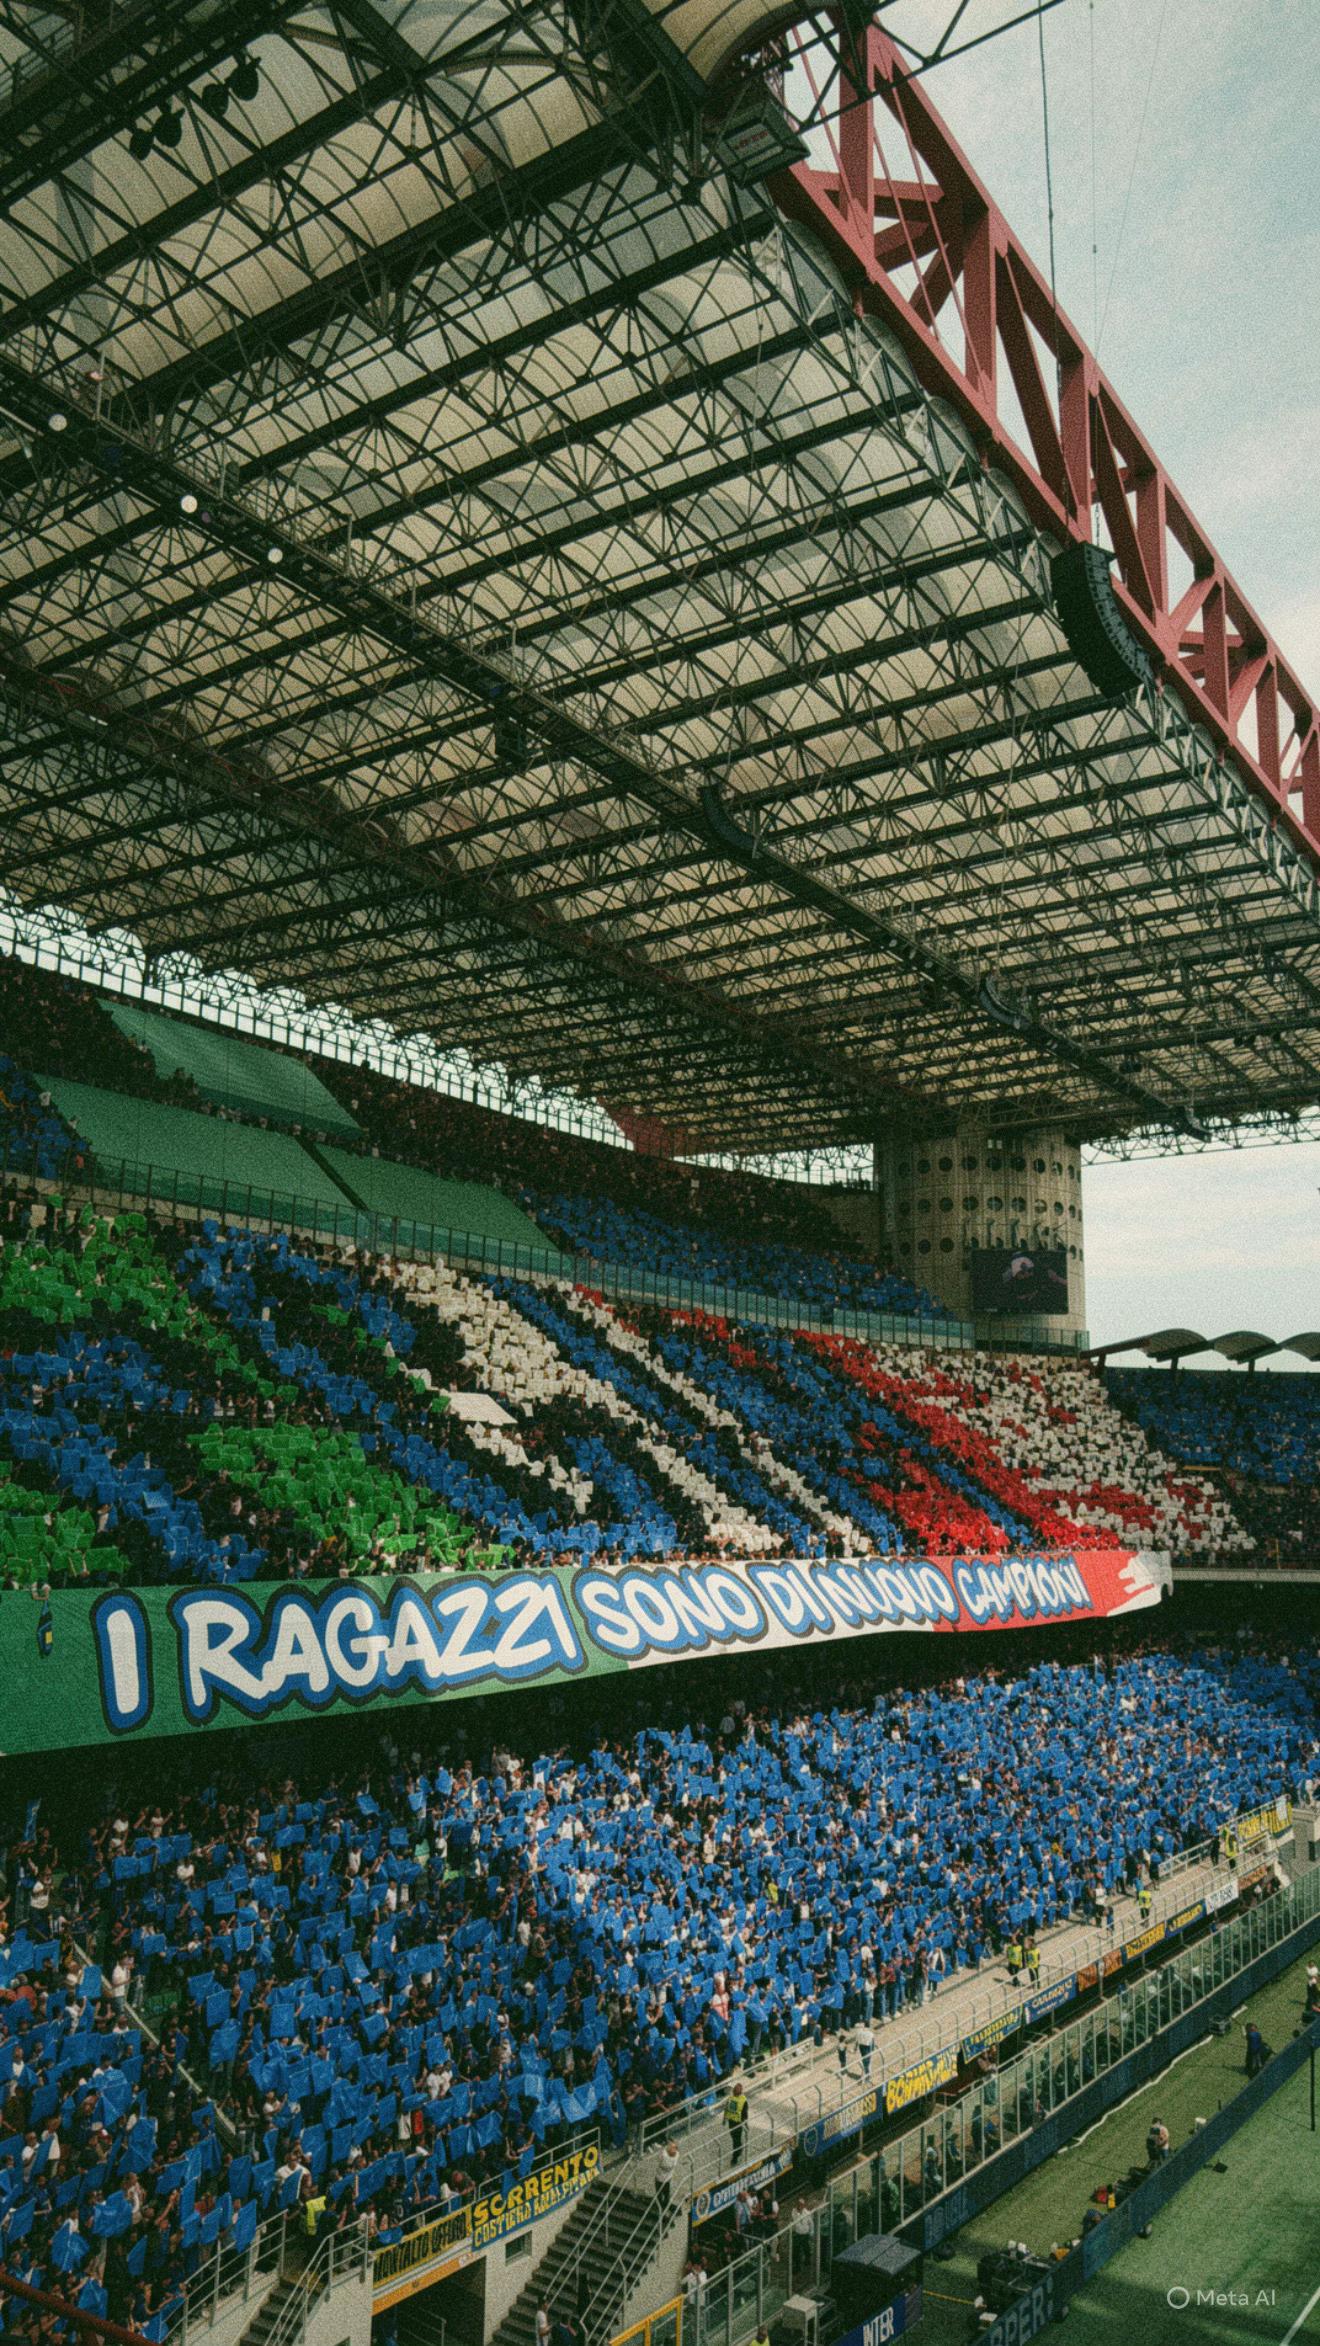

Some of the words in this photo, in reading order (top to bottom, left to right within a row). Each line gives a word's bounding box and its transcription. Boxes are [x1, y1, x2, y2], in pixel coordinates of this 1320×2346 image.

[101, 1600, 146, 1722] I
[179, 1577, 580, 1712] RAGAZZI
[580, 1563, 761, 1652] SONO
[756, 1564, 829, 1631] DI
[814, 1561, 955, 1623] NUOVO
[954, 1558, 1091, 1619] CAMPIONI
[473, 2146, 599, 2227] SORRENTO
